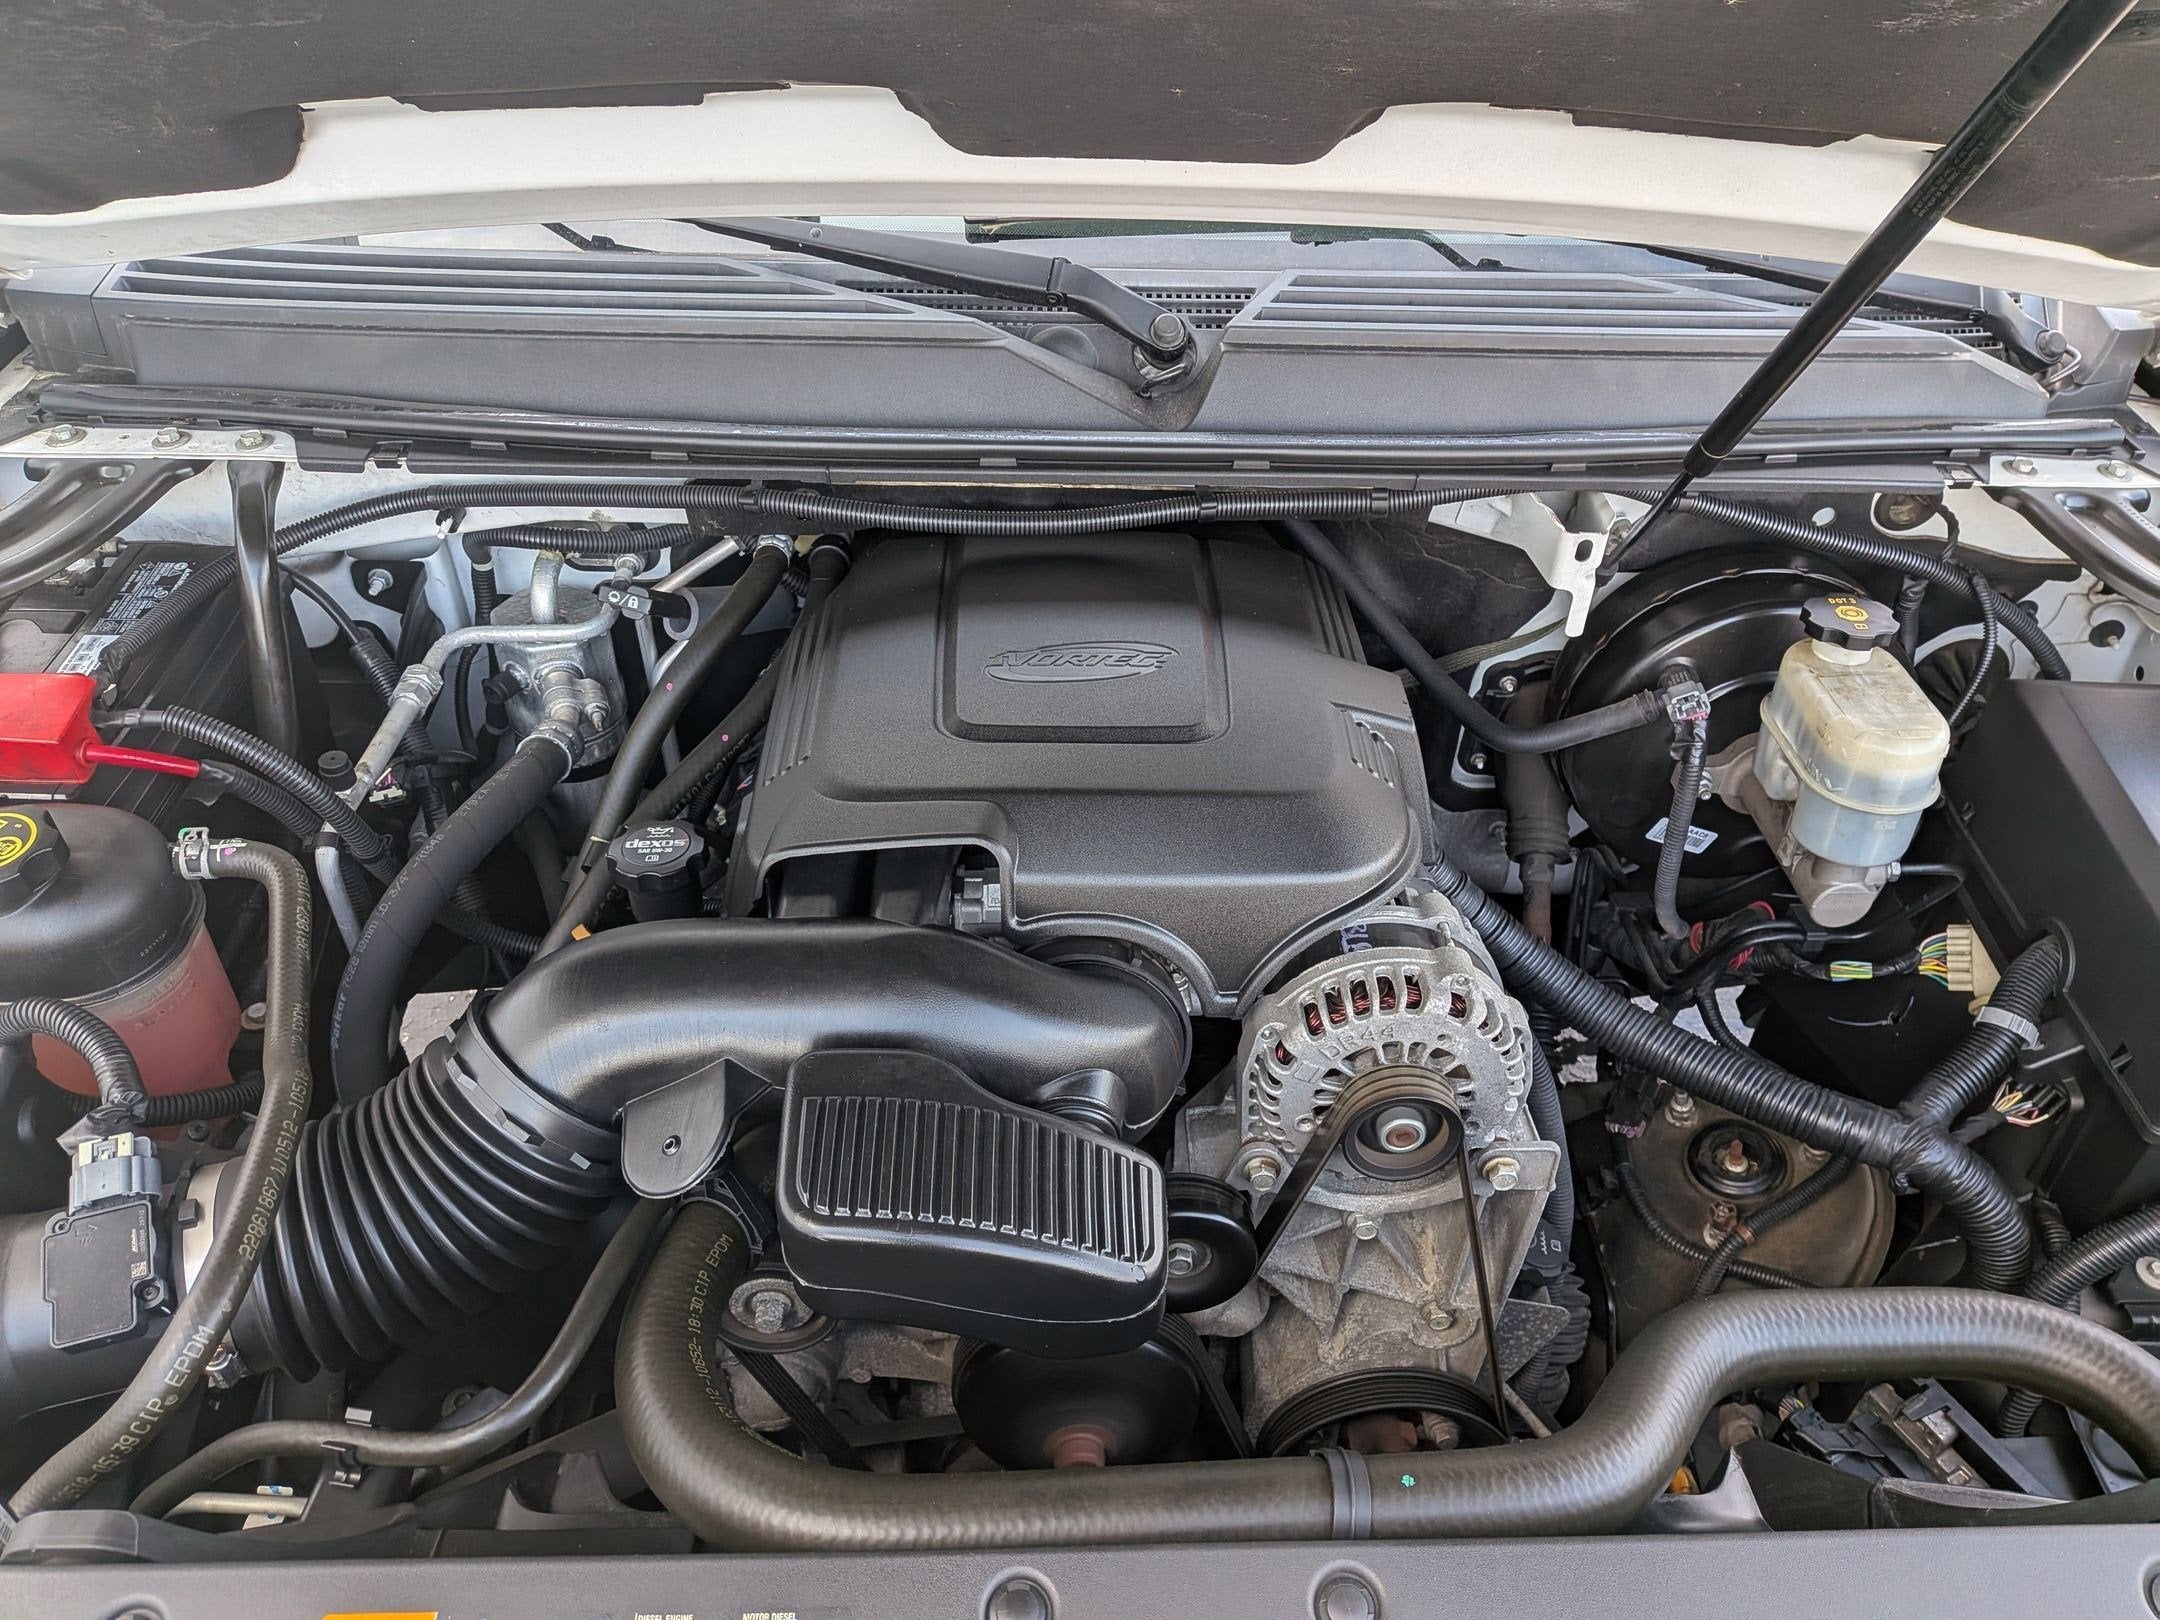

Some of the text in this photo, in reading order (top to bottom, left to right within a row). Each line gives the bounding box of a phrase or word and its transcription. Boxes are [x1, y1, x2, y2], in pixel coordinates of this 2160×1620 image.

[1827, 597, 1848, 605] DOT
[1002, 651, 1164, 668] VORTEC
[624, 838, 688, 849] dexos
[238, 1176, 281, 1261] 22861867
[705, 1232, 734, 1268] EPDM
[129, 1397, 166, 1436] CIP
[164, 1324, 215, 1388] EPDM
[742, 1612, 797, 1620] MOTOR DIESEL
